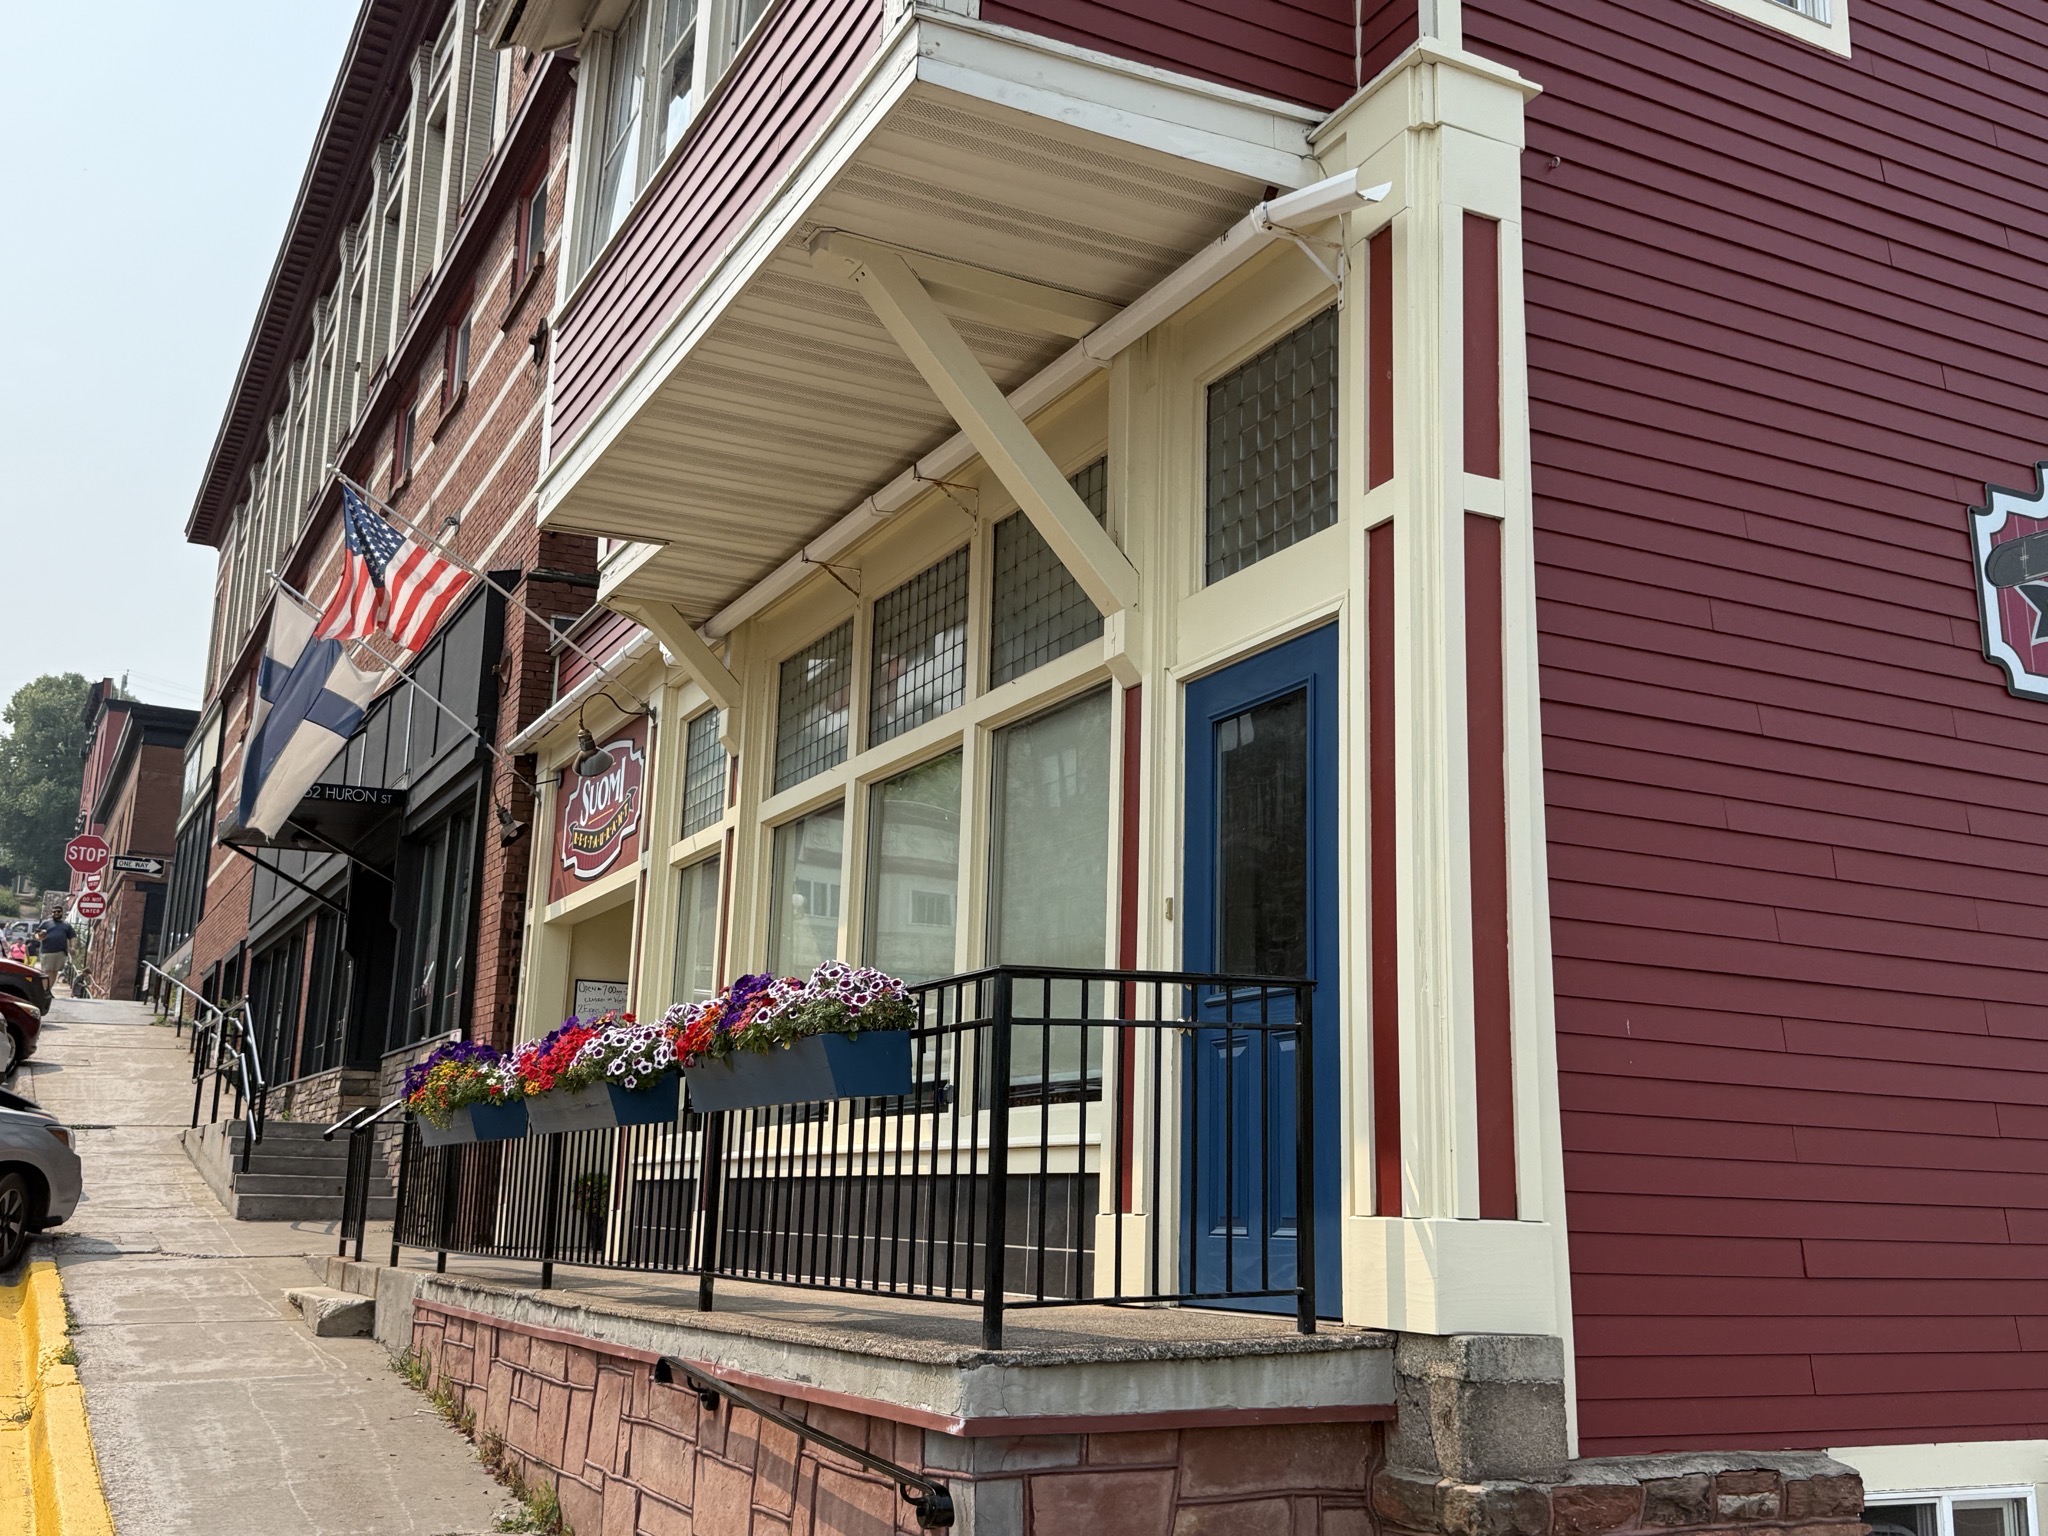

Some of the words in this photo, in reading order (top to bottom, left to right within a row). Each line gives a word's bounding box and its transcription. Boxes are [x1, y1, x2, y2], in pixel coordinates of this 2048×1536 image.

[325, 786, 377, 803] HURON
[381, 794, 392, 804] ST
[580, 756, 626, 827] SUOMI
[68, 845, 107, 863] STOP
[135, 861, 149, 869] WAY
